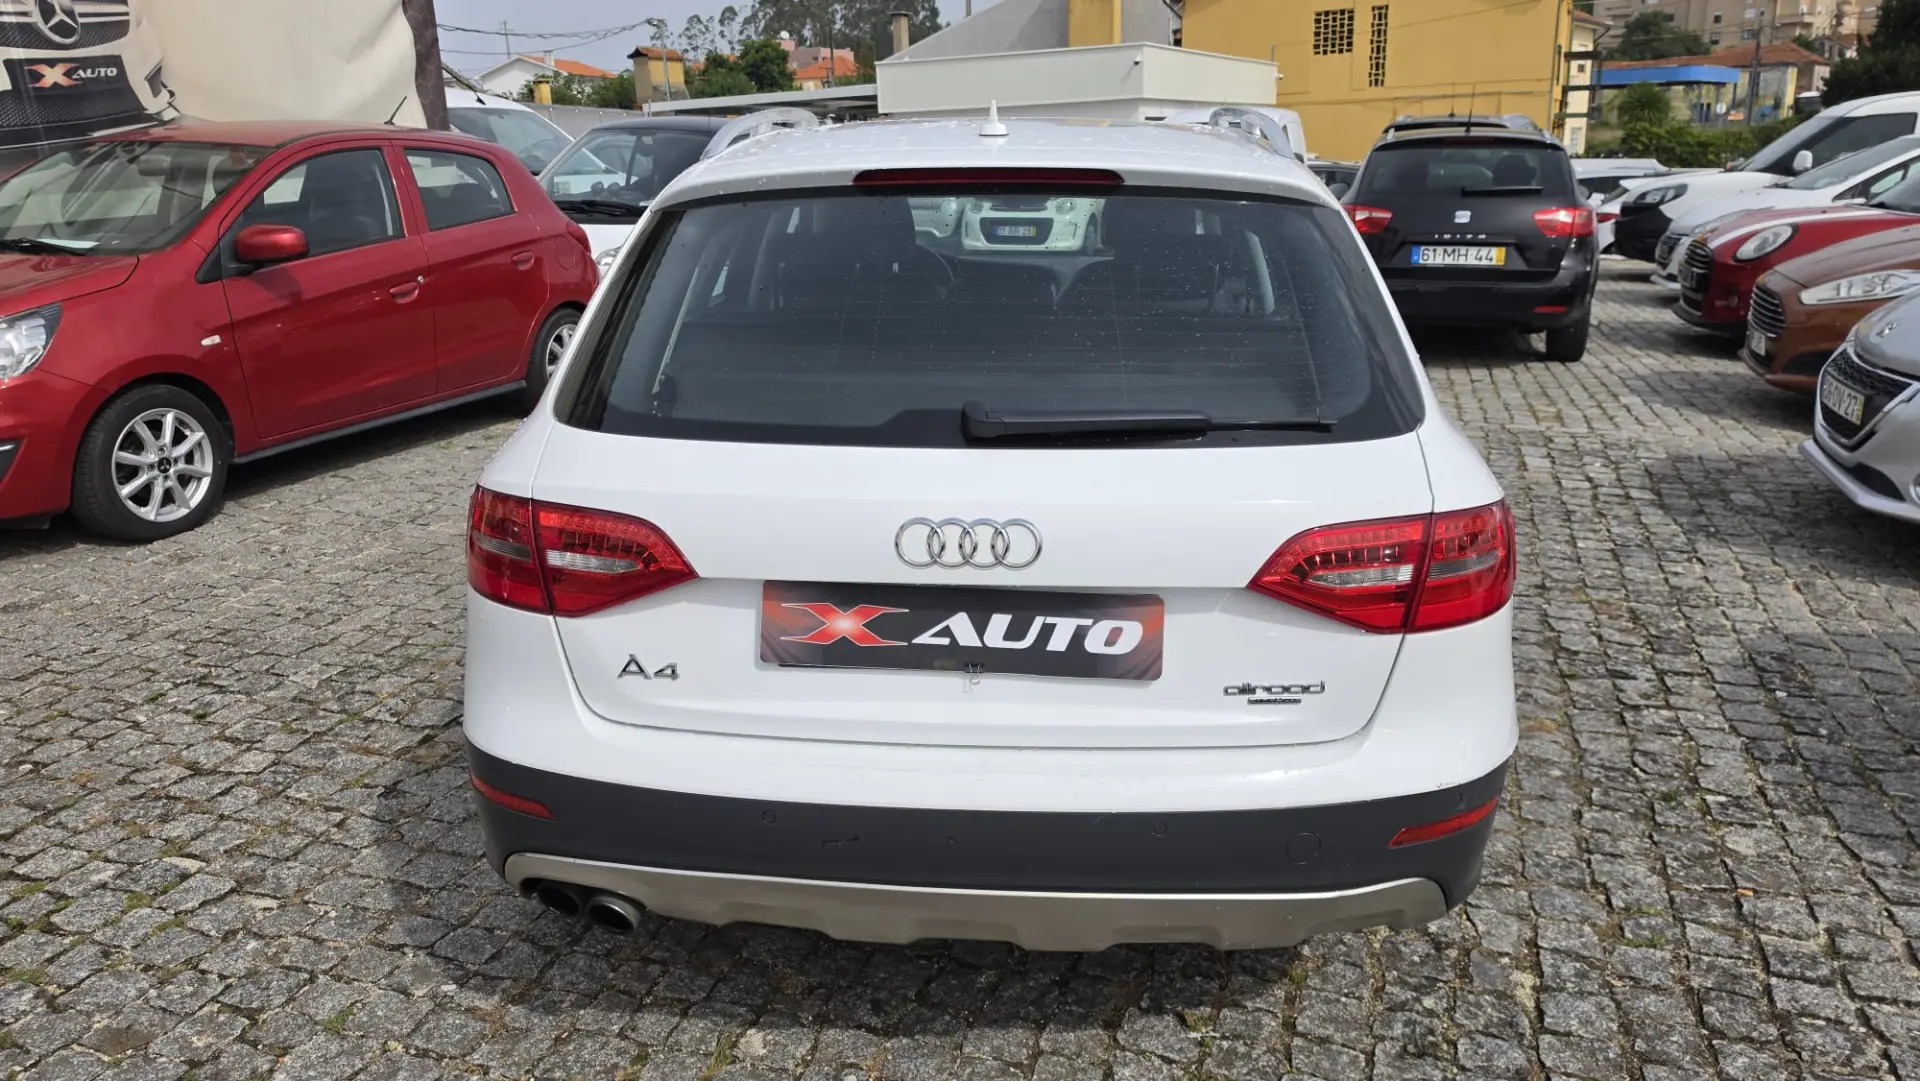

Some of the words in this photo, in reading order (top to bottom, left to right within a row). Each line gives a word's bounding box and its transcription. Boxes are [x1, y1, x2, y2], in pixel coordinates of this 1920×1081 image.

[24, 63, 83, 88] X
[72, 67, 117, 78] AUTO
[780, 602, 909, 647] X
[910, 611, 1144, 656] AUTO
[616, 653, 679, 682] A4
[1223, 680, 1326, 696] allroad
